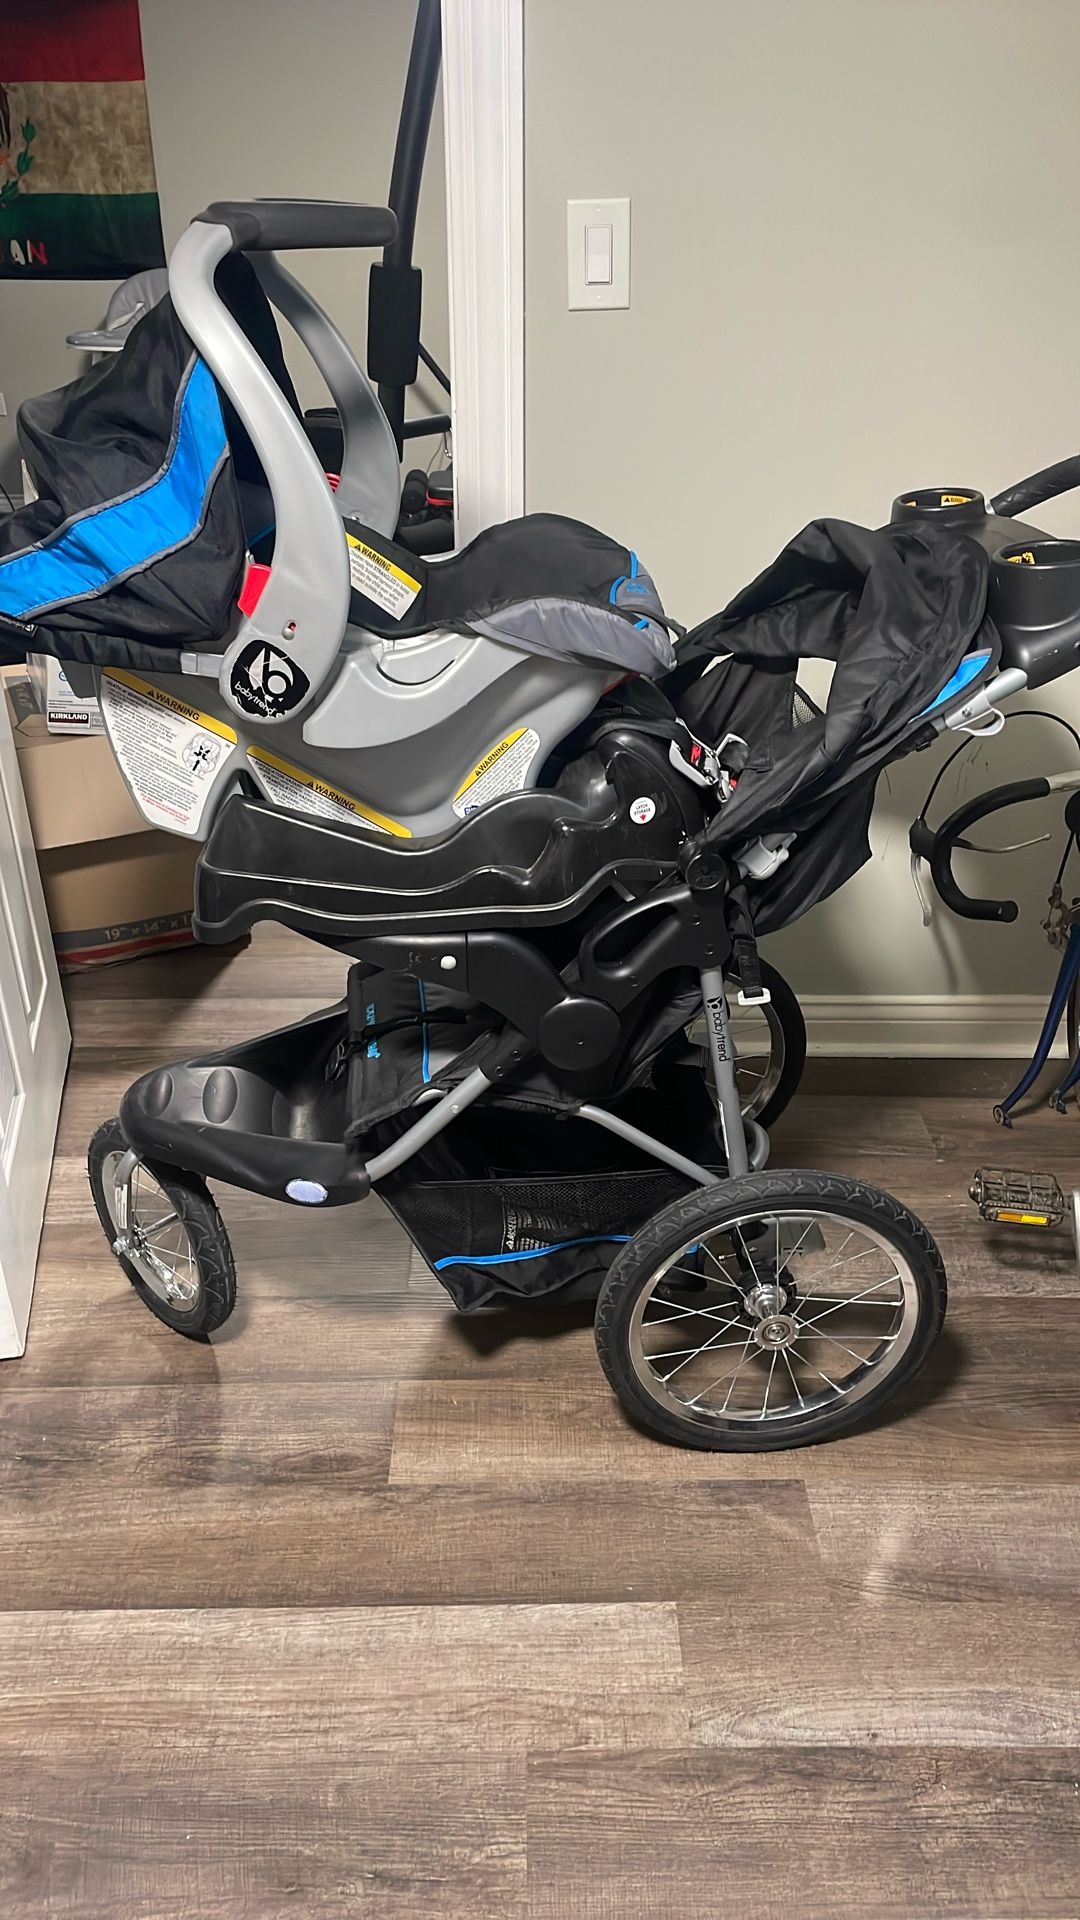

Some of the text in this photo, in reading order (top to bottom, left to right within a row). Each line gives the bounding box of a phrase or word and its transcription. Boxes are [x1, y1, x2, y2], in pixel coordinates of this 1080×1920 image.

[361, 546, 391, 572] WARNING
[156, 692, 200, 721] WARNING
[234, 681, 275, 717] babytrend
[479, 741, 509, 771] WARNING
[314, 782, 355, 810] WARNING
[712, 1010, 731, 1061] babytrend
